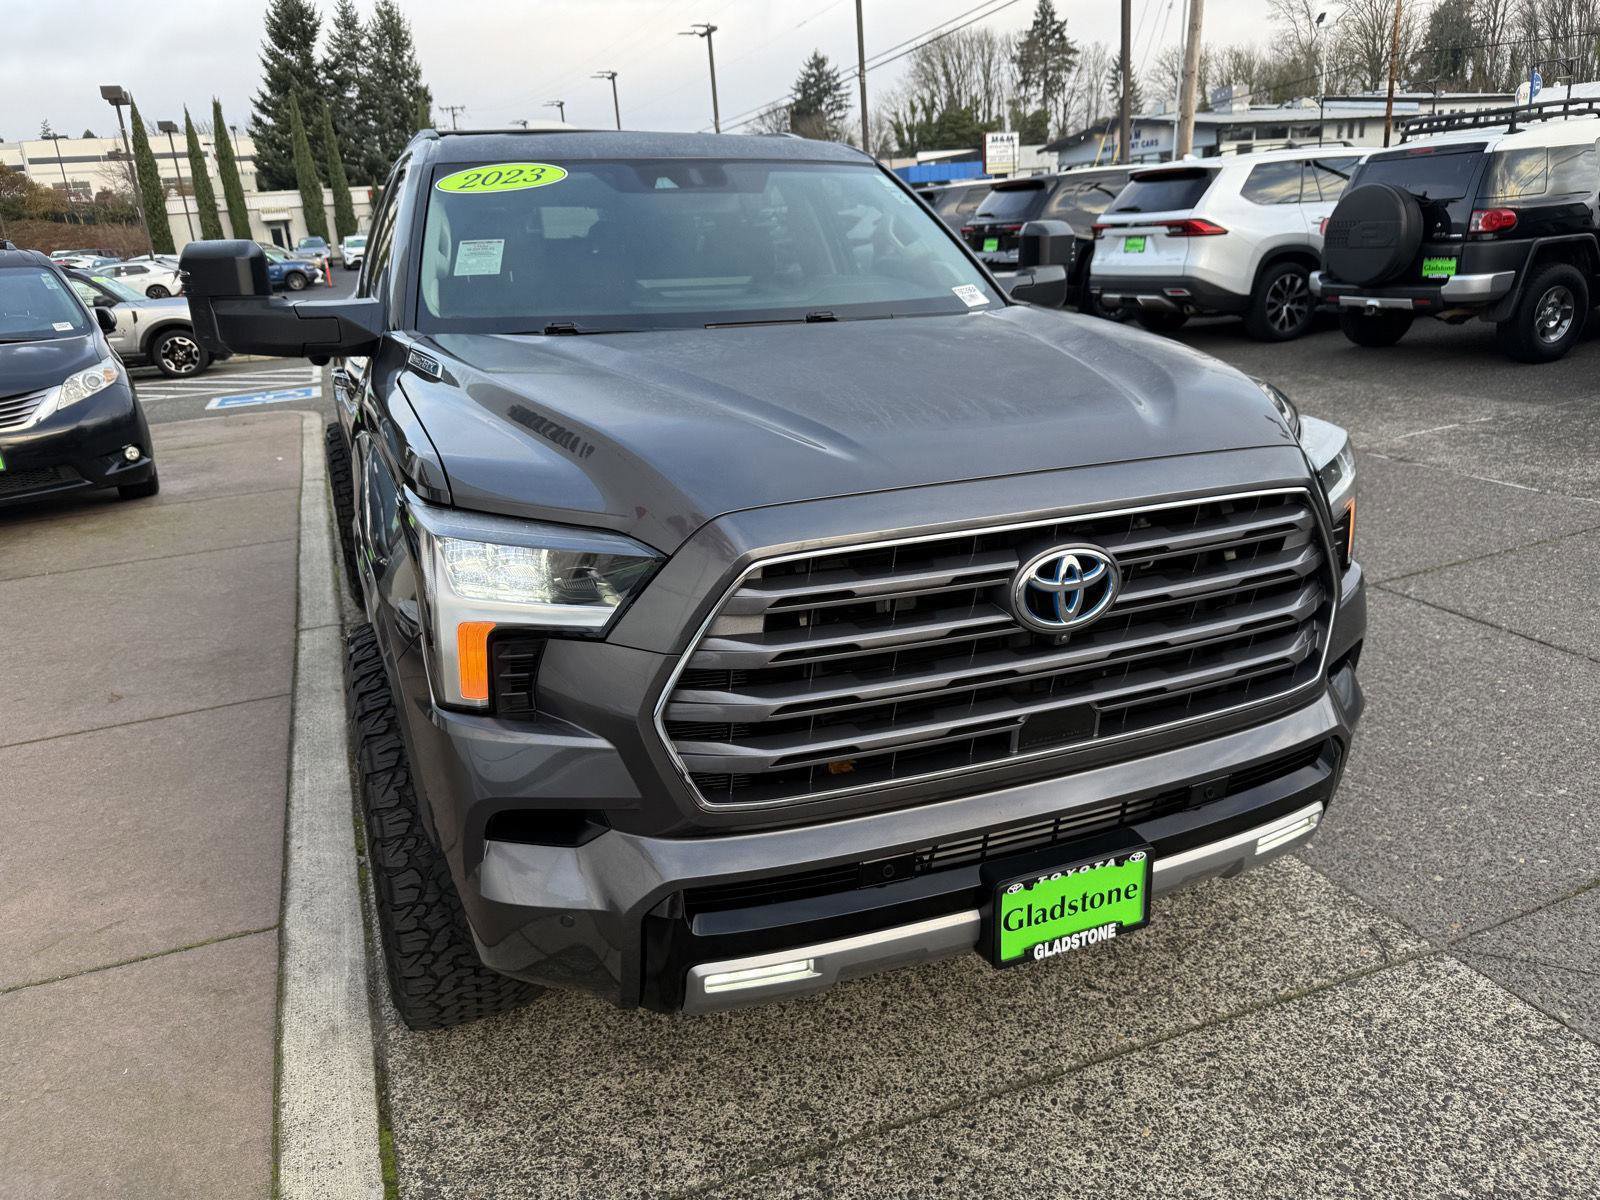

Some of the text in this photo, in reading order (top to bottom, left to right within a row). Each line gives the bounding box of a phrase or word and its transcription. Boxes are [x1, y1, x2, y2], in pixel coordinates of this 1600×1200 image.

[1141, 139, 1159, 149] CARS
[457, 168, 546, 190] 2023
[1037, 858, 1116, 884] TOYOTA
[1003, 883, 1138, 932] Gladstone
[1033, 922, 1117, 960] GLADSTONE
